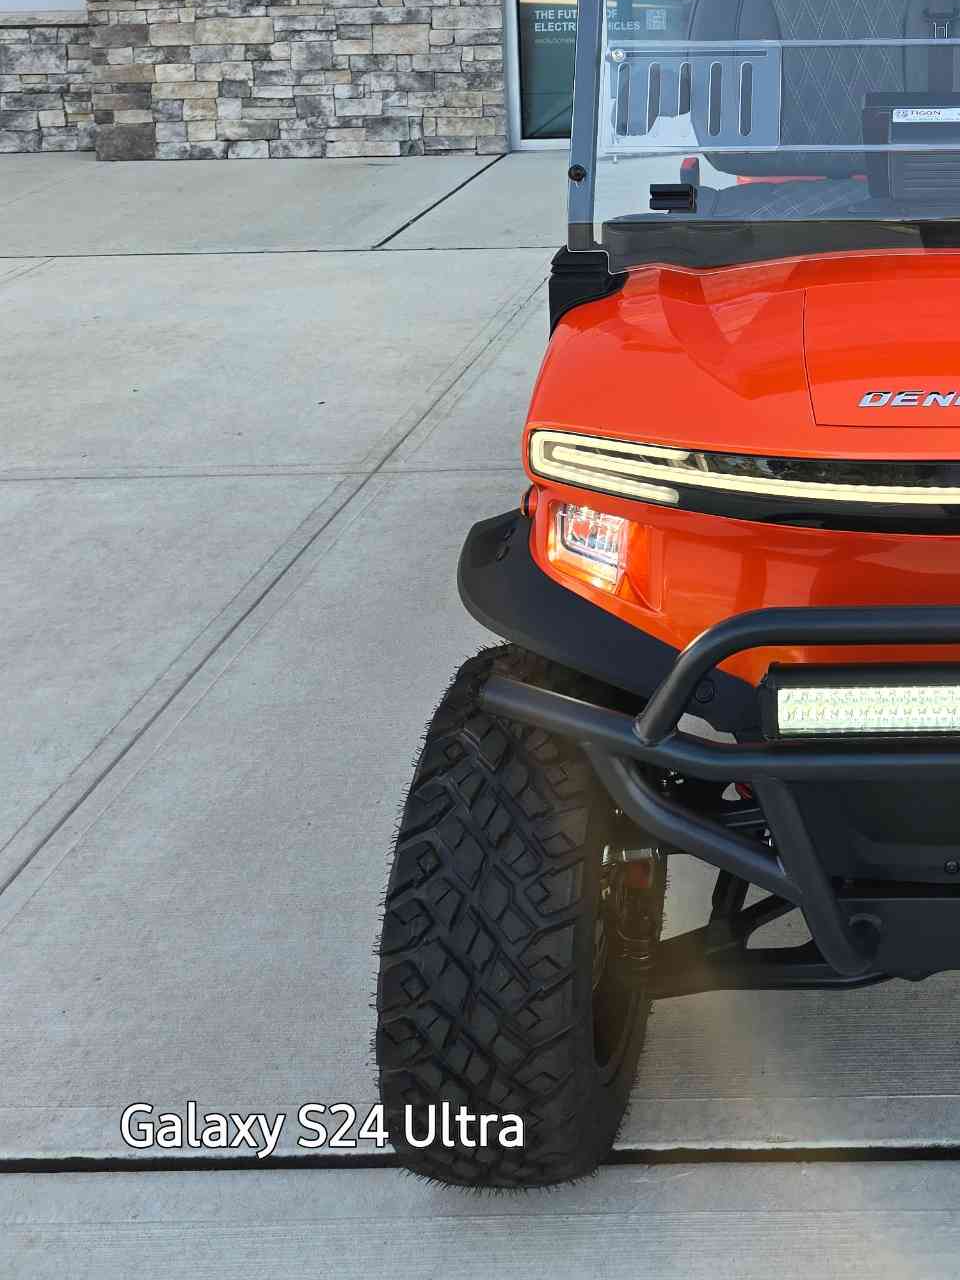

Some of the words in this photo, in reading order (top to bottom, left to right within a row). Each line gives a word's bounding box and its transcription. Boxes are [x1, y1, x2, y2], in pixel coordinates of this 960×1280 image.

[534, 9, 555, 20] THE
[557, 9, 577, 20] FUT
[534, 22, 577, 33] ELECTR
[607, 21, 641, 32] HICLES
